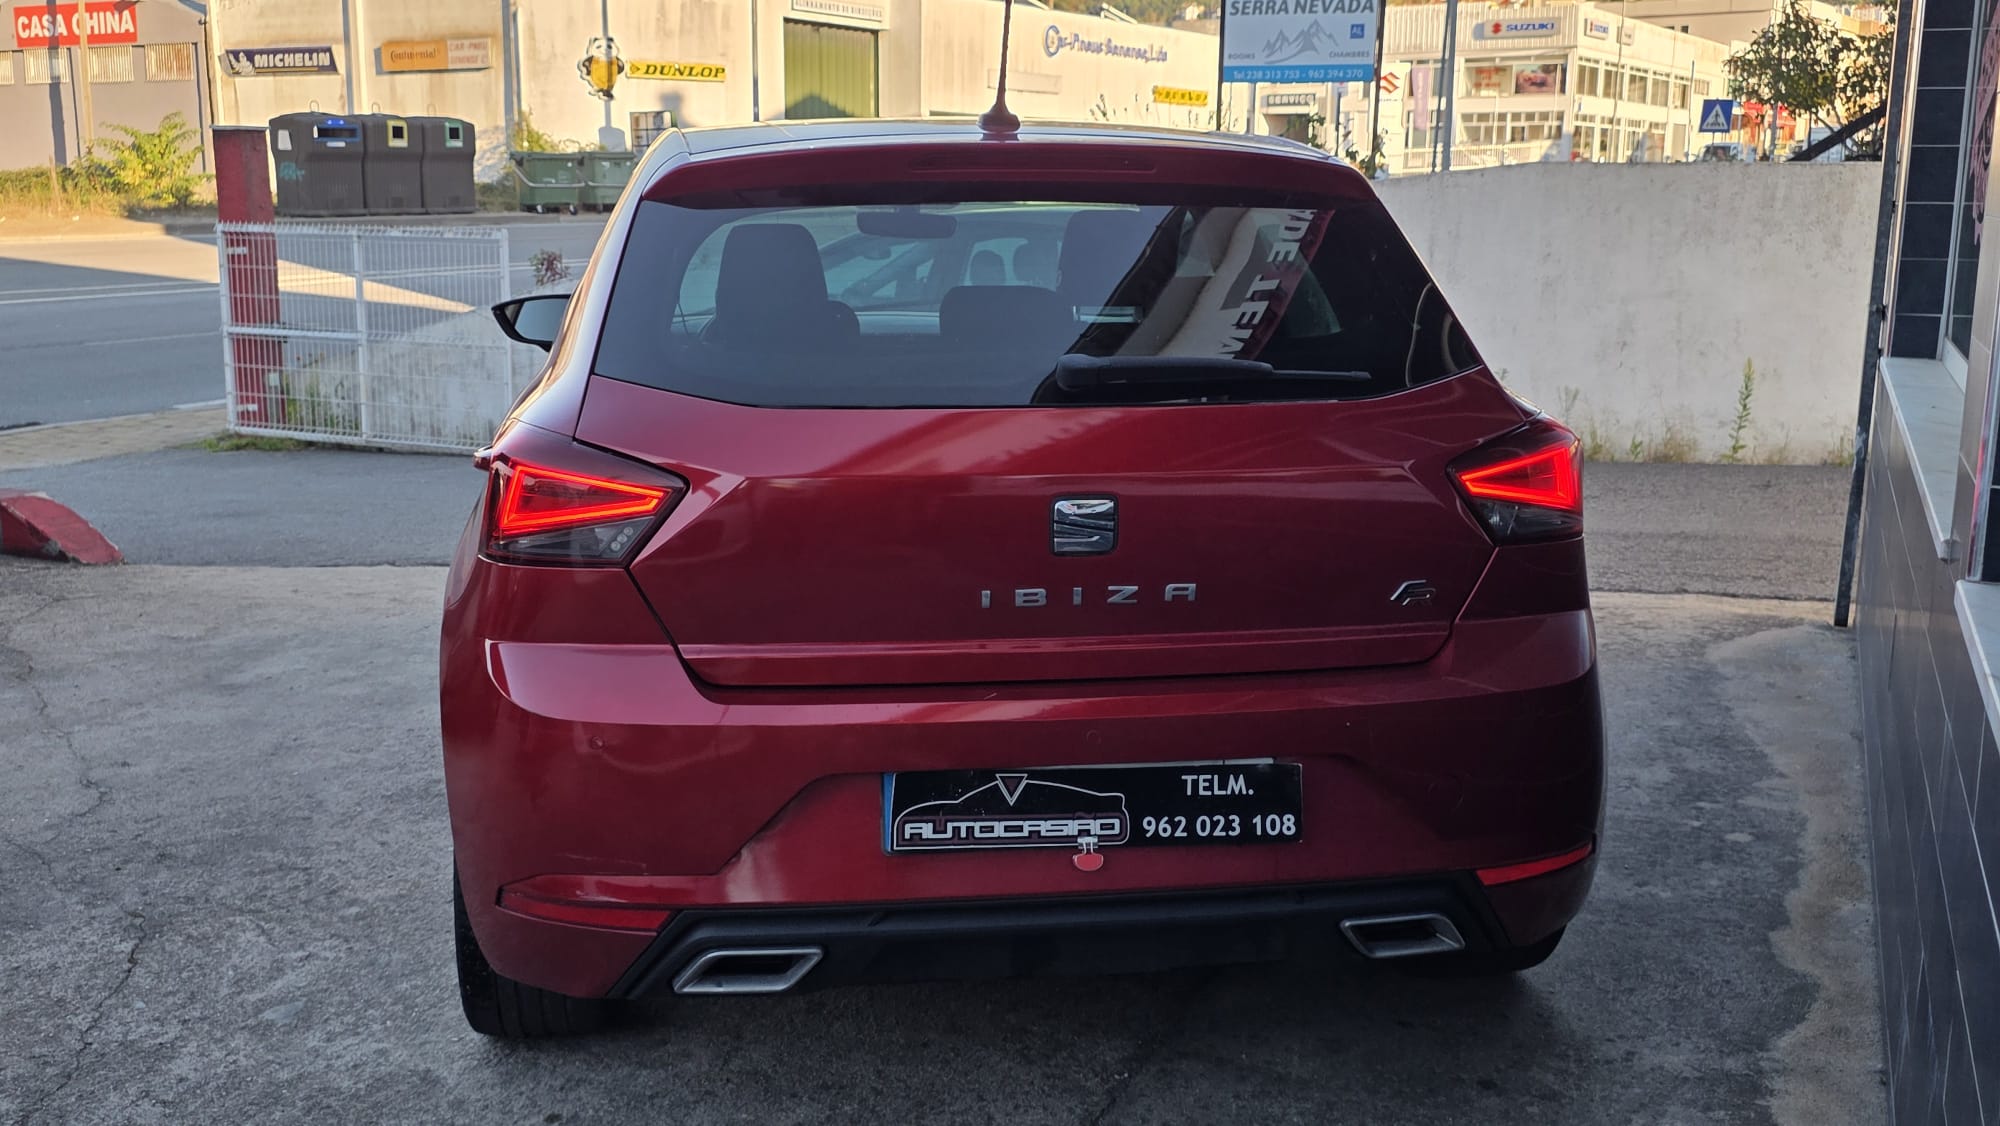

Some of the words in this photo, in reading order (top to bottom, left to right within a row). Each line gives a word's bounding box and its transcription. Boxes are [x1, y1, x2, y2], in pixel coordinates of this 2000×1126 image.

[1229, 0, 1289, 16] SERRA
[1293, 0, 1374, 15] NEVADA
[17, 13, 68, 39] CASA
[71, 10, 135, 35] CHINA
[1505, 21, 1555, 33] SUZUKI
[254, 51, 331, 68] MICHELIN
[1228, 52, 1255, 60] ROOMS
[1329, 50, 1370, 58] CHAMBRES
[643, 63, 726, 78] DUNLOP
[980, 583, 1197, 609] IBIZA
[1181, 774, 1254, 796] TELM.
[1142, 815, 1188, 838] 962
[1195, 815, 1241, 837] 023
[1251, 814, 1297, 836] 108
